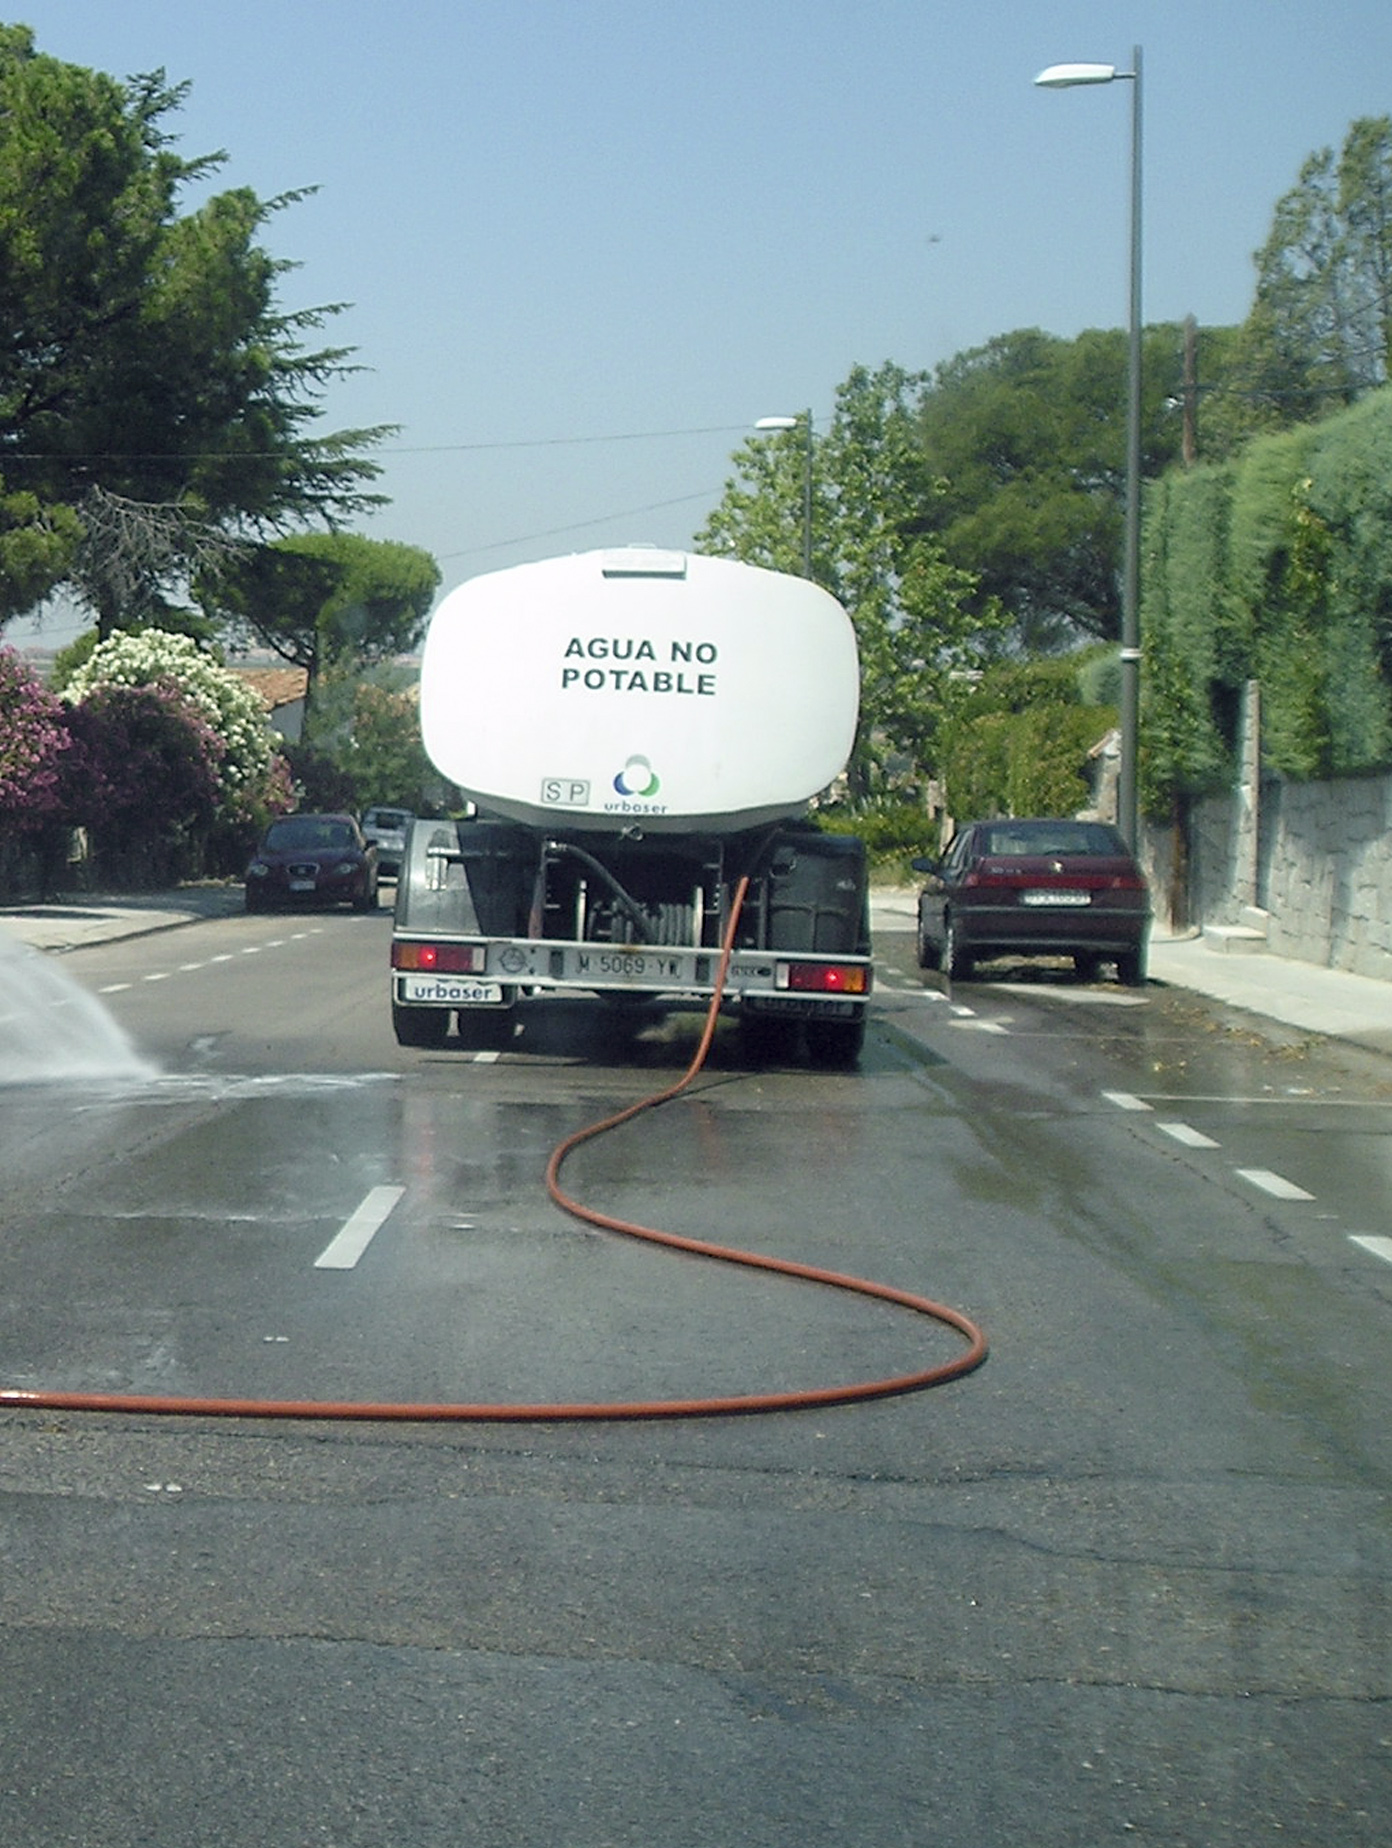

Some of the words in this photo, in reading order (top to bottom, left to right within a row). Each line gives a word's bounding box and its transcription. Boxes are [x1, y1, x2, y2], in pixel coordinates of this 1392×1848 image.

[564, 637, 656, 661] AGUA
[671, 641, 718, 664] NO
[562, 668, 716, 695] POTABLE
[604, 801, 668, 814] urbaser
[414, 985, 493, 999] urbaser
